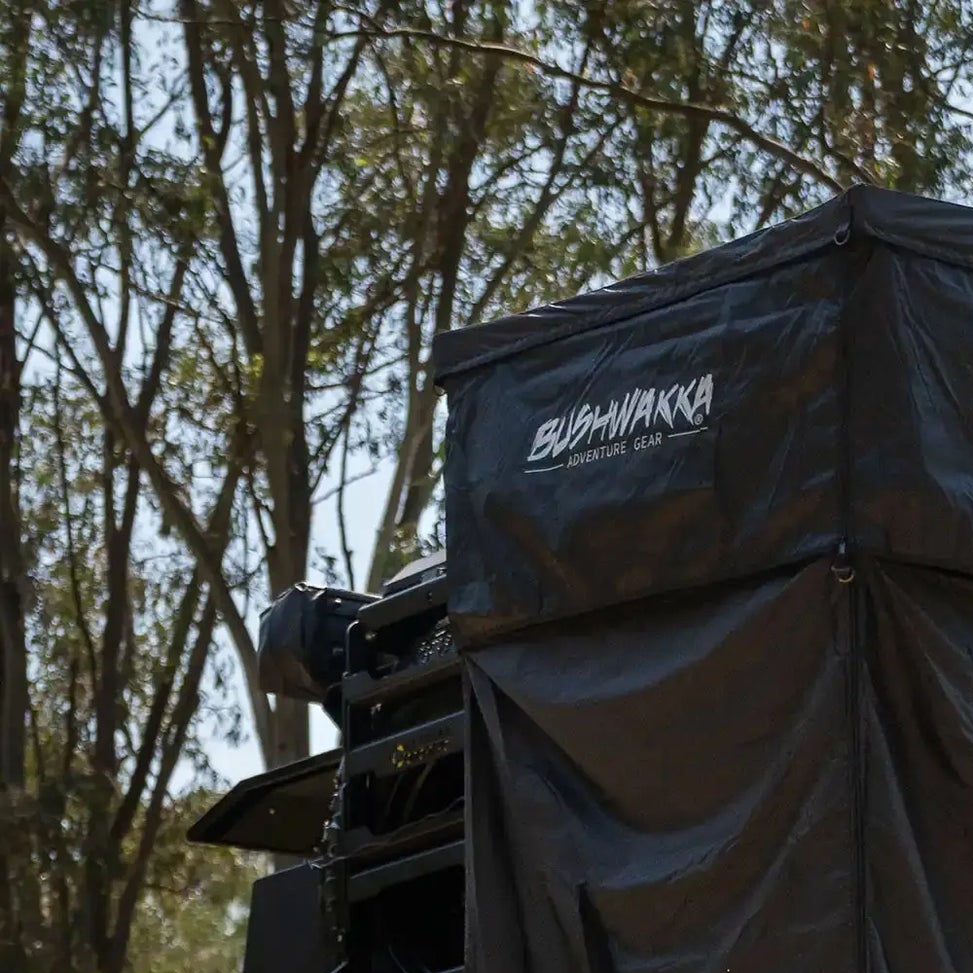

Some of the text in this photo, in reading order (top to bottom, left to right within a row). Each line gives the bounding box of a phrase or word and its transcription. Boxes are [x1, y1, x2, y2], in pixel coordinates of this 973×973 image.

[527, 373, 713, 462] BUSHWAKKA
[566, 432, 663, 469] ADVENTURE GEAR
